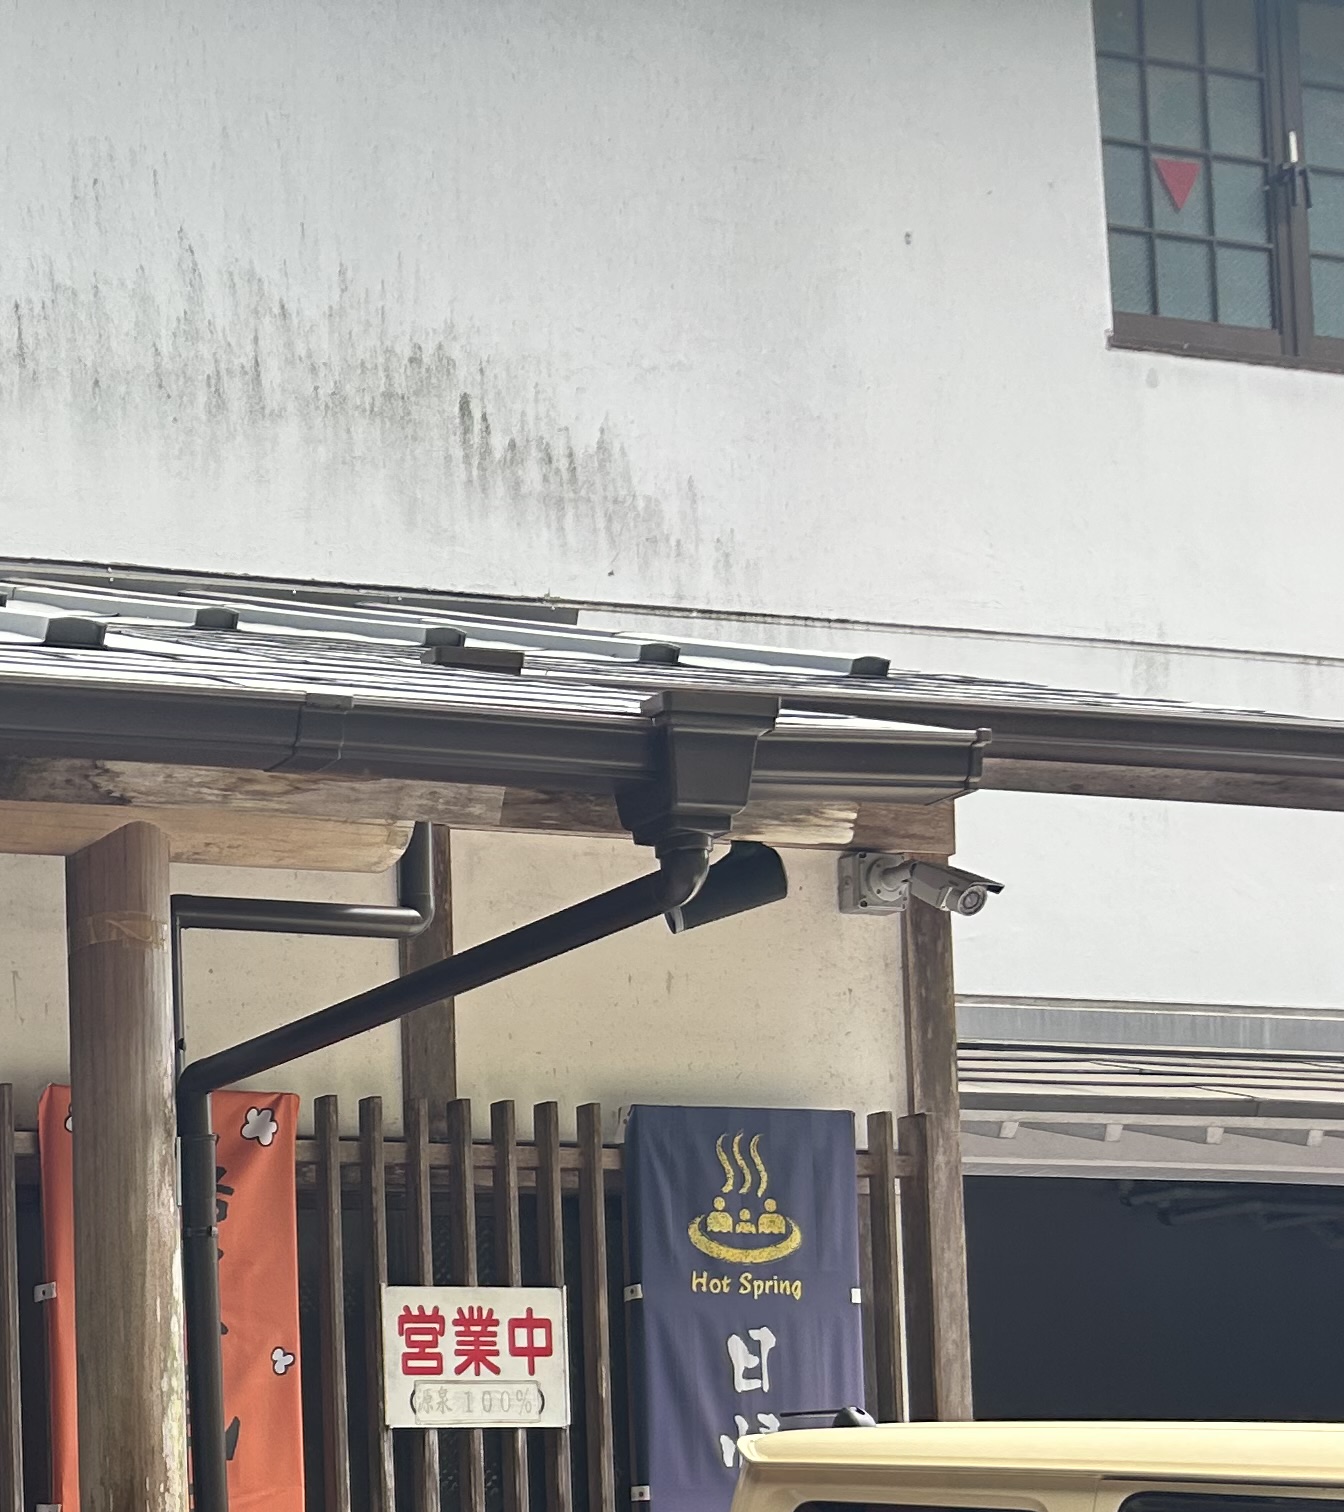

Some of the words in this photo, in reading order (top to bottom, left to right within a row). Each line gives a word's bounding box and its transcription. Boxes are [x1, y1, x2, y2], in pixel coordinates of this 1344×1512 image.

[691, 1270, 732, 1293] Hot
[738, 1272, 802, 1301] Spring
[397, 1304, 554, 1377] 営業中
